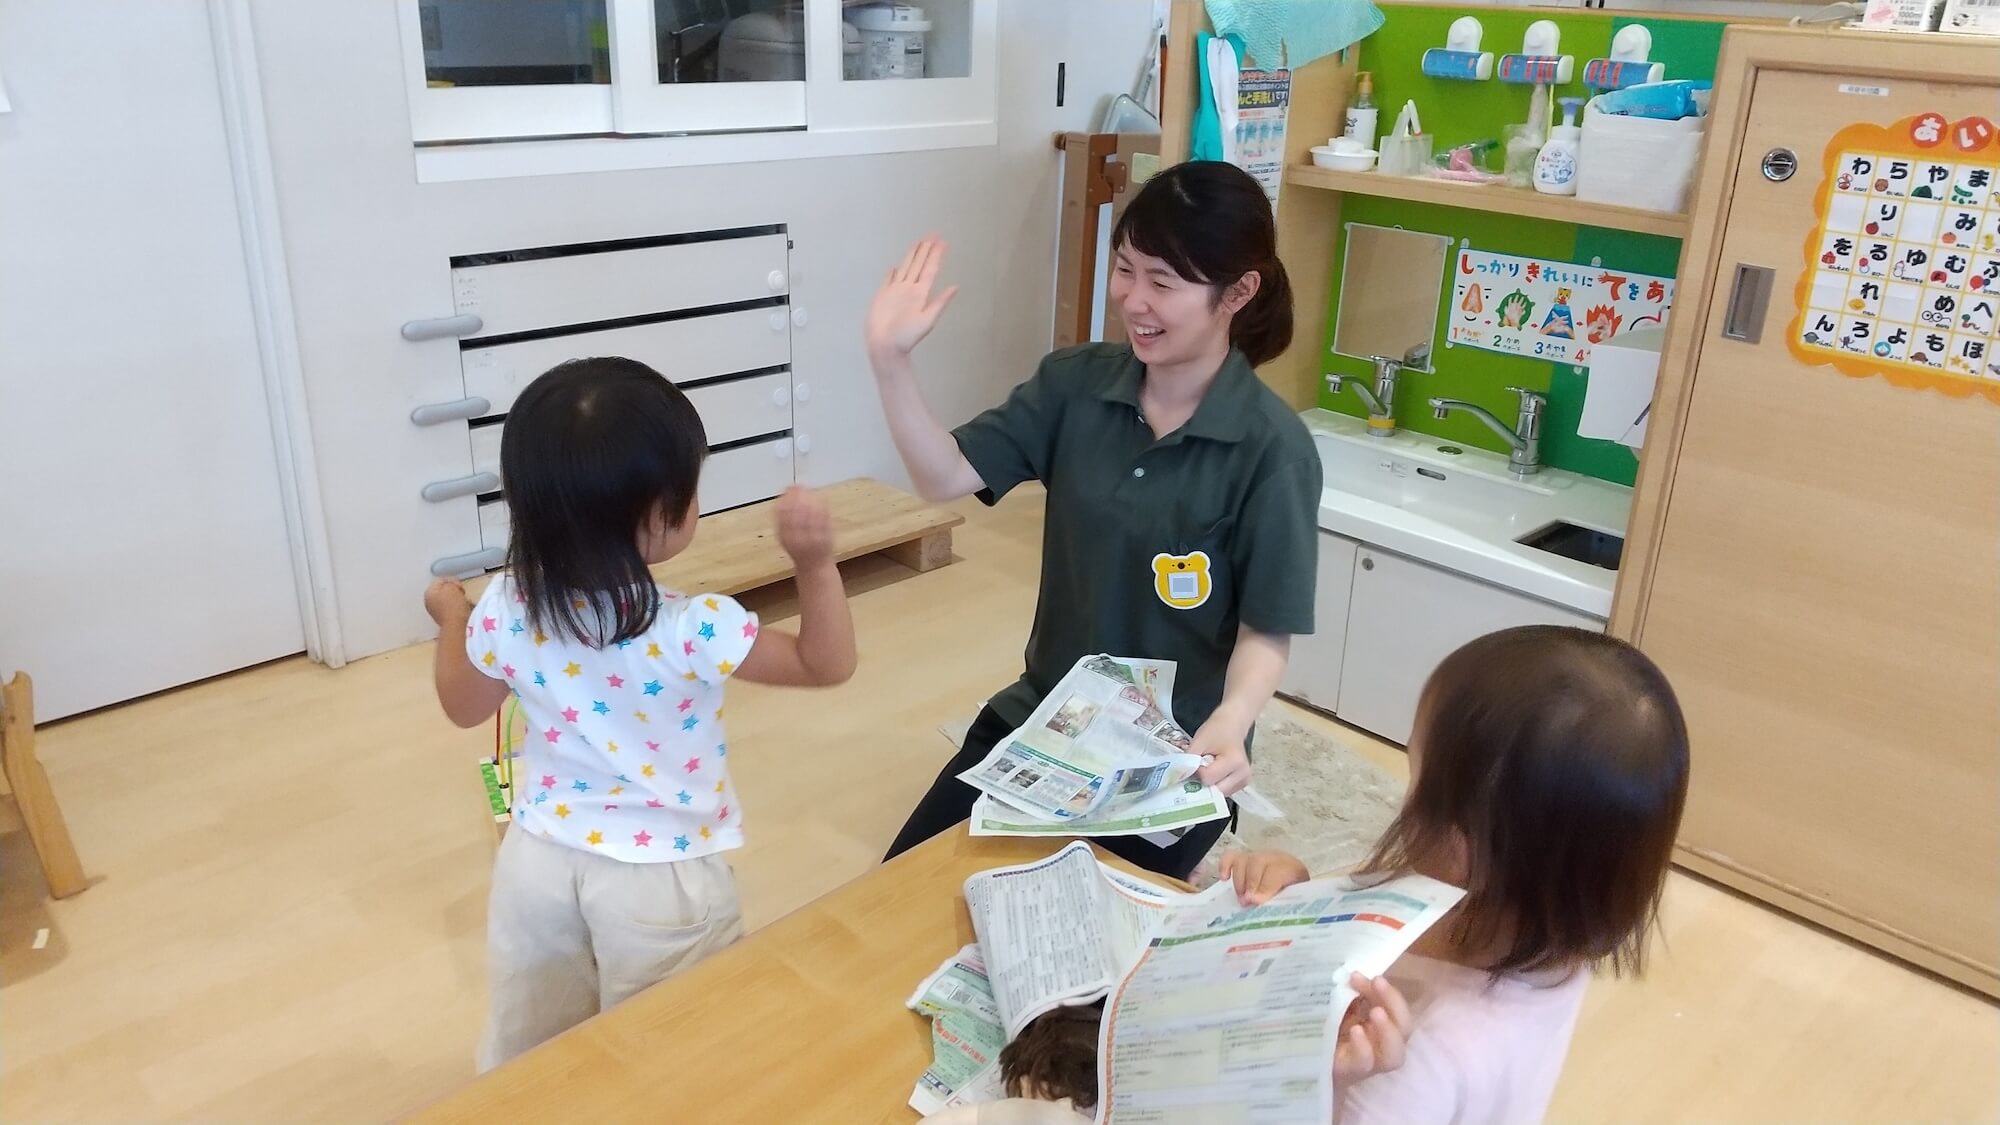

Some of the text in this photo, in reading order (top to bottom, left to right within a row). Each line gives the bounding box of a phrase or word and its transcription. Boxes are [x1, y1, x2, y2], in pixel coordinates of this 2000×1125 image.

[1852, 157, 1990, 188] わ ら や ま
[1881, 204, 1977, 231] り み
[1833, 238, 1852, 256] を
[1870, 243, 1887, 261] る
[1906, 249, 1927, 266] ゆ
[1944, 255, 1966, 274] む
[1860, 282, 1993, 319] れ め へ
[1453, 327, 1459, 340] 1
[1493, 334, 1503, 348] 2
[1815, 314, 1985, 359] ん ろ よ も ほ
[1534, 341, 1544, 354] 3
[1575, 348, 1585, 362] 4
